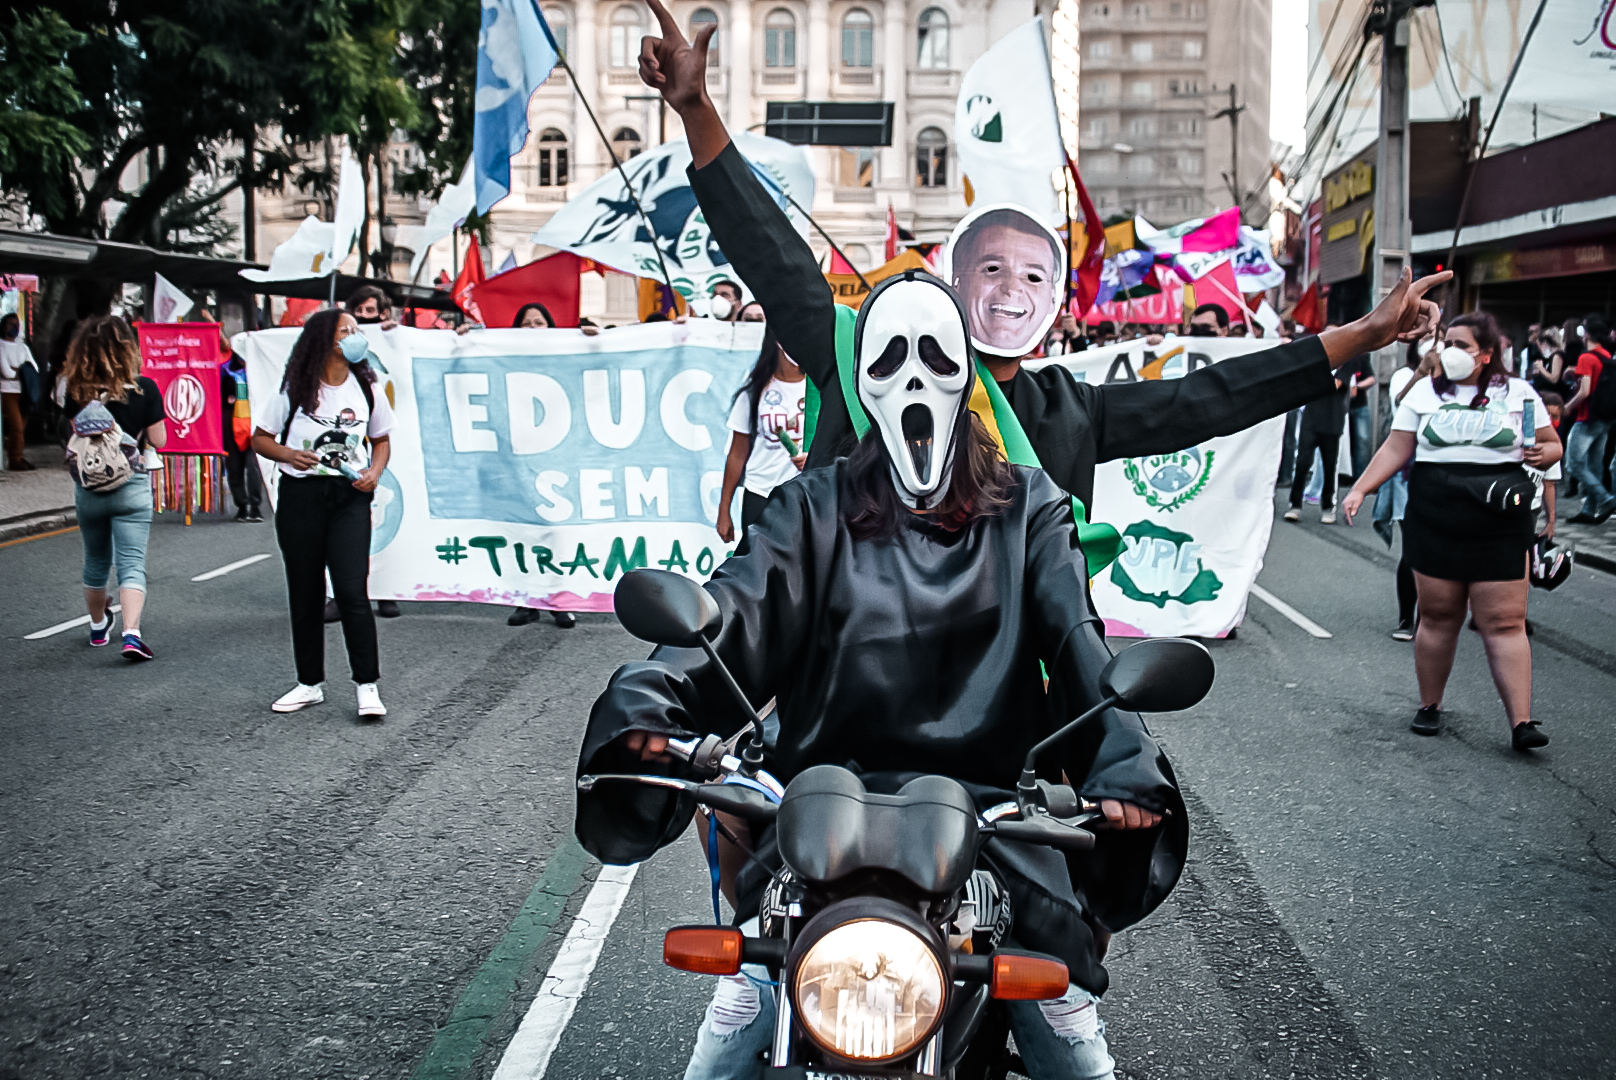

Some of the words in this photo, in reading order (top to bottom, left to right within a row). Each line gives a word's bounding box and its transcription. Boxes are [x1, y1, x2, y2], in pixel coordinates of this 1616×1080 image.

[444, 368, 752, 456] EDUC
[535, 467, 669, 522] SEM
[1123, 535, 1203, 574] UPE
